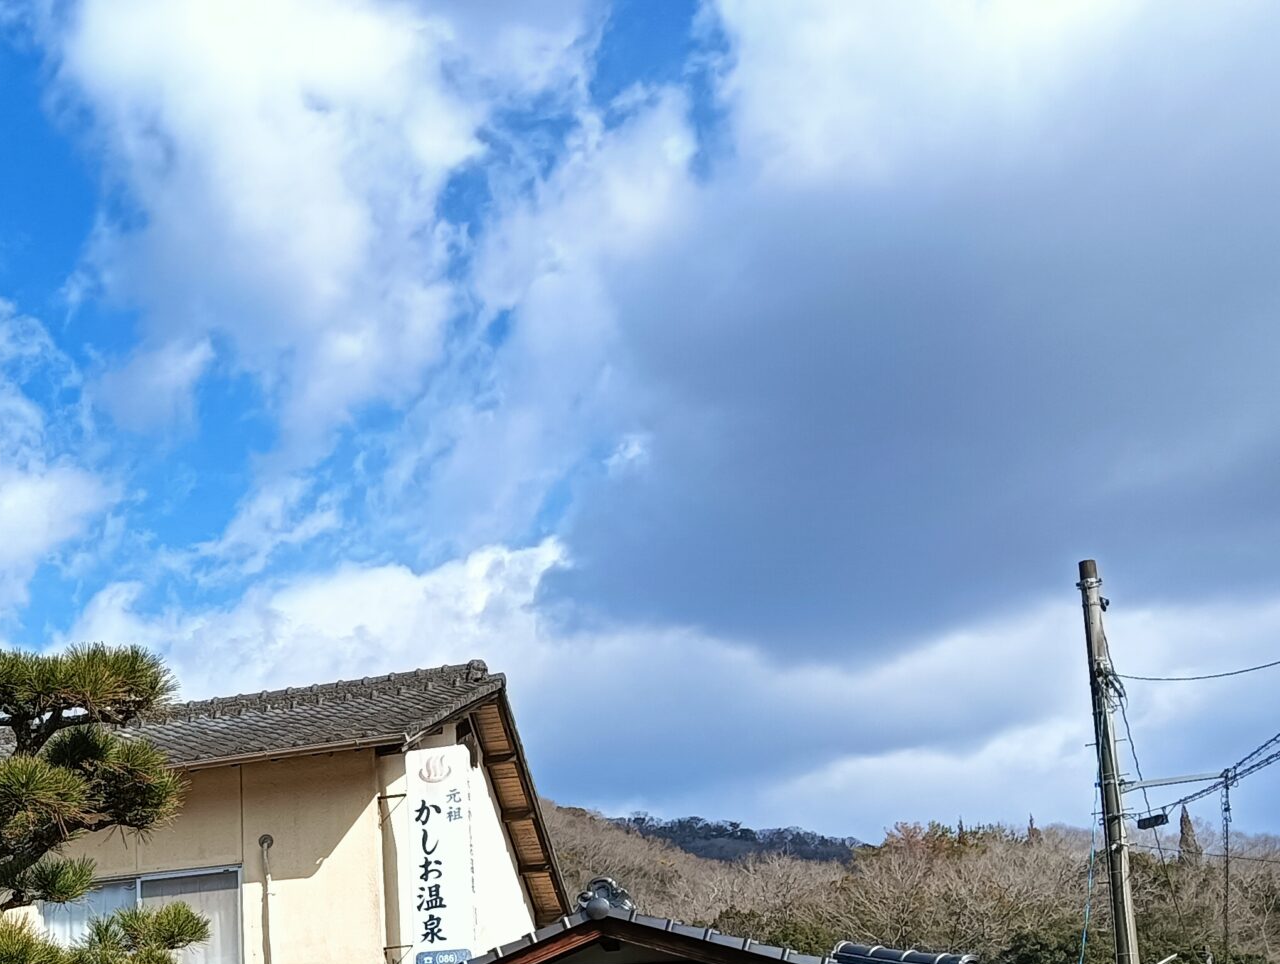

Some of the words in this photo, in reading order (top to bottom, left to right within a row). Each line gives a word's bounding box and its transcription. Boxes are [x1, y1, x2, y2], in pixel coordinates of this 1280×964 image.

[446, 789, 463, 822] 元祖
[414, 800, 447, 943] かしお温泉
